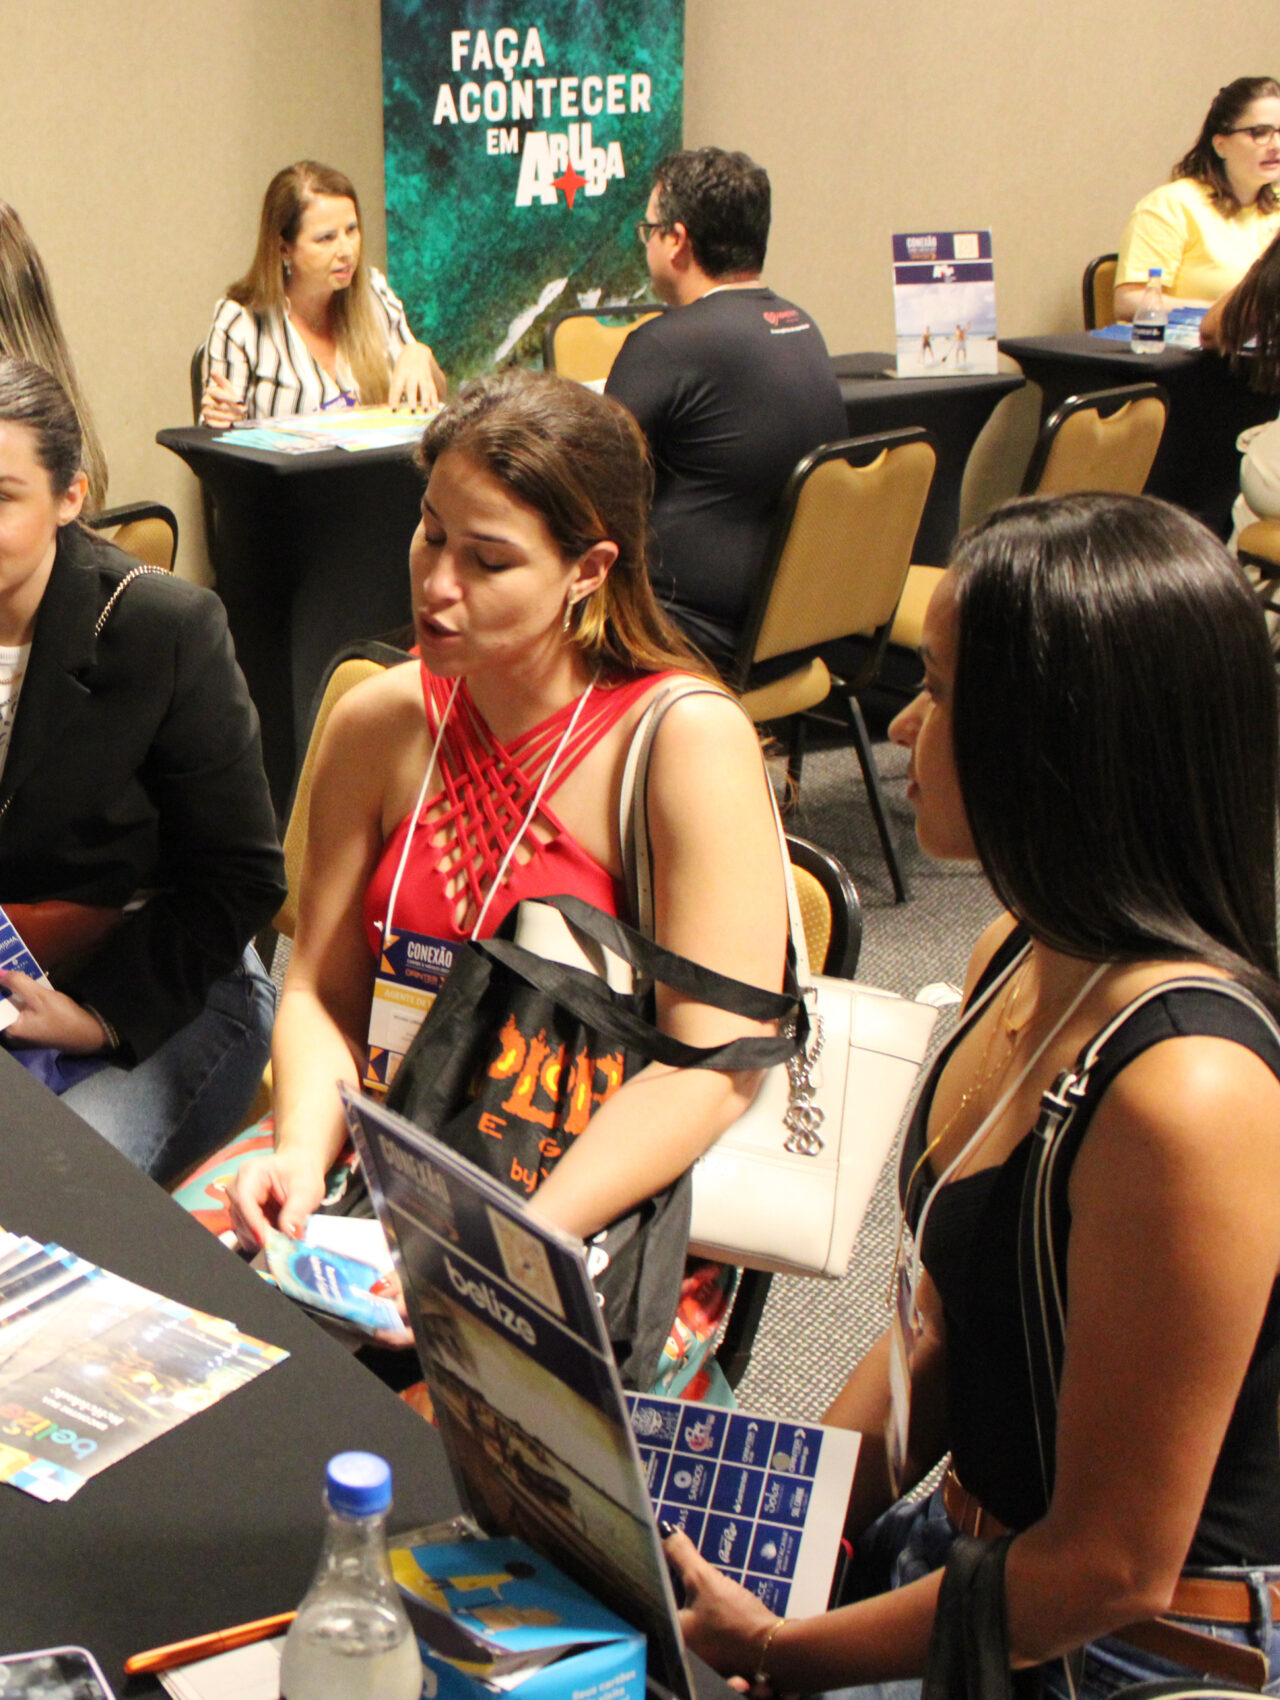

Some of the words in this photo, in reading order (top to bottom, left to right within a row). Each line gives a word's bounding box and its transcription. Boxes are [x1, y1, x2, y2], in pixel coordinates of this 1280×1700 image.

[451, 27, 545, 82] FAÇA
[433, 73, 651, 125] ACONTECER
[486, 127, 519, 155] EM
[515, 122, 625, 207] ARUBA
[407, 941, 453, 968] CONEXÃO
[443, 1255, 537, 1347] belize
[765, 1481, 780, 1513] Solar
